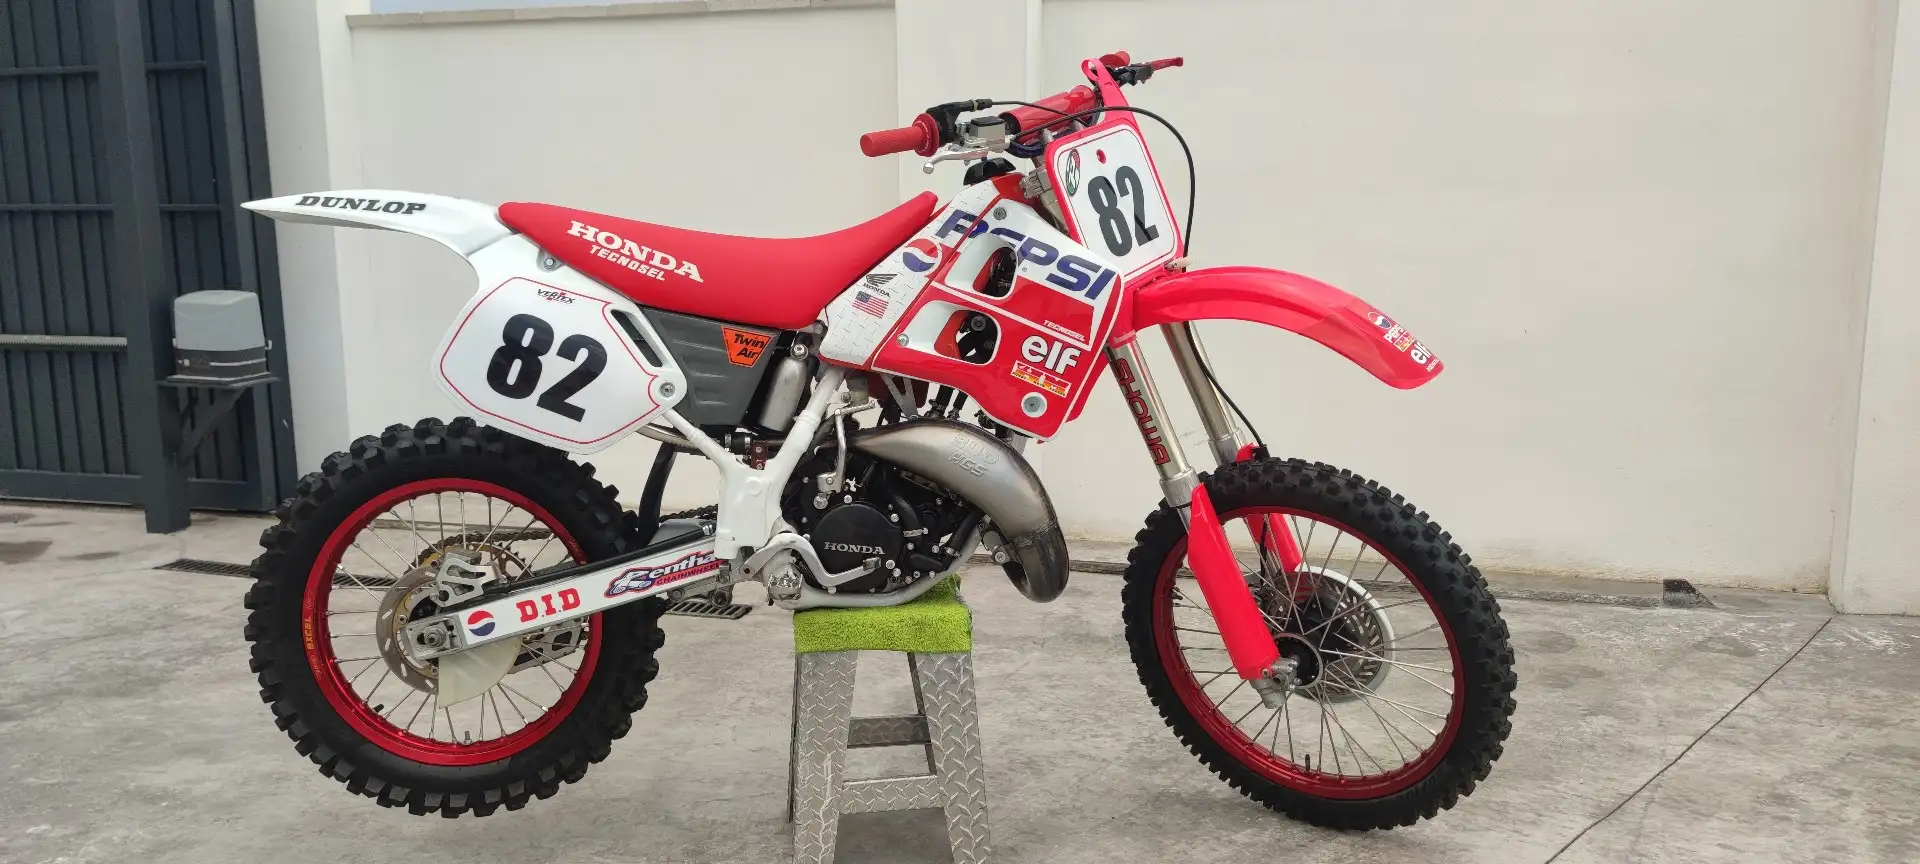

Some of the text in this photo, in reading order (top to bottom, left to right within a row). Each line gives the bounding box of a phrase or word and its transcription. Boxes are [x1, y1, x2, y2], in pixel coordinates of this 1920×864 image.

[295, 196, 427, 214] DUNLOP
[1087, 165, 1160, 257] 82
[567, 220, 704, 283] HONDA
[589, 244, 666, 281] TECNOSEL
[862, 282, 892, 298] HONDA
[734, 333, 765, 349] Twin
[736, 347, 759, 359] Air
[1021, 335, 1082, 375] elf
[486, 313, 608, 423] 82
[1116, 357, 1172, 465] SHOWA
[824, 541, 886, 555] HONDA
[304, 616, 315, 650] EXCEL
